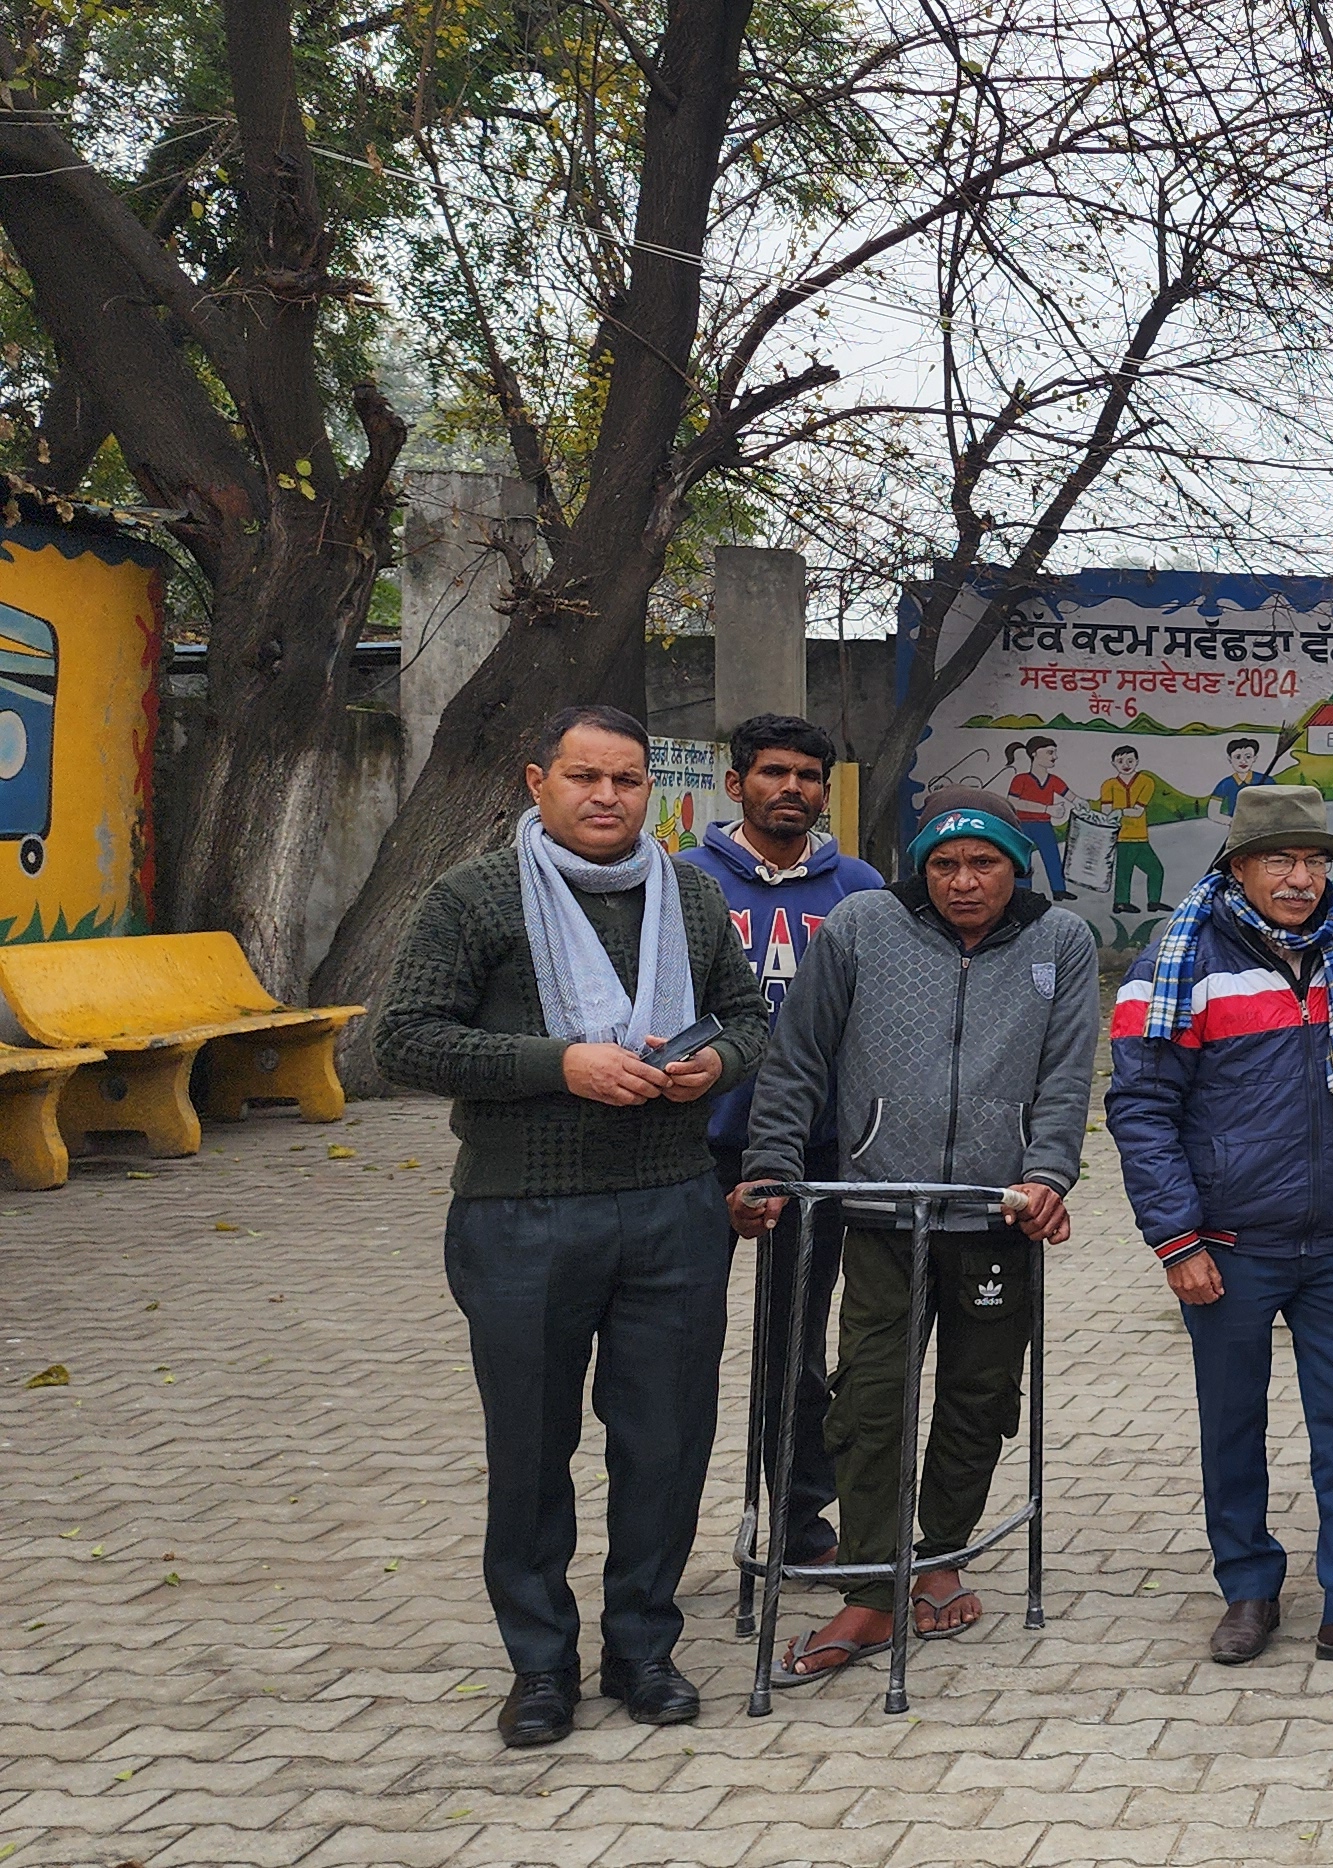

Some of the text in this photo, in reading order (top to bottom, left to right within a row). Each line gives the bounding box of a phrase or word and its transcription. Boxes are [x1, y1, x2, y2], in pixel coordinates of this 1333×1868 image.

[1071, 622, 1159, 657] ਕਦਮ
[1163, 618, 1294, 662] ਸਵੱਛਤਾ
[1019, 662, 1112, 691] ਸਵੱਛਤਾ
[1116, 660, 1225, 694] ਸਰਵੇਖਣ
[974, 1297, 1003, 1306] adidas
